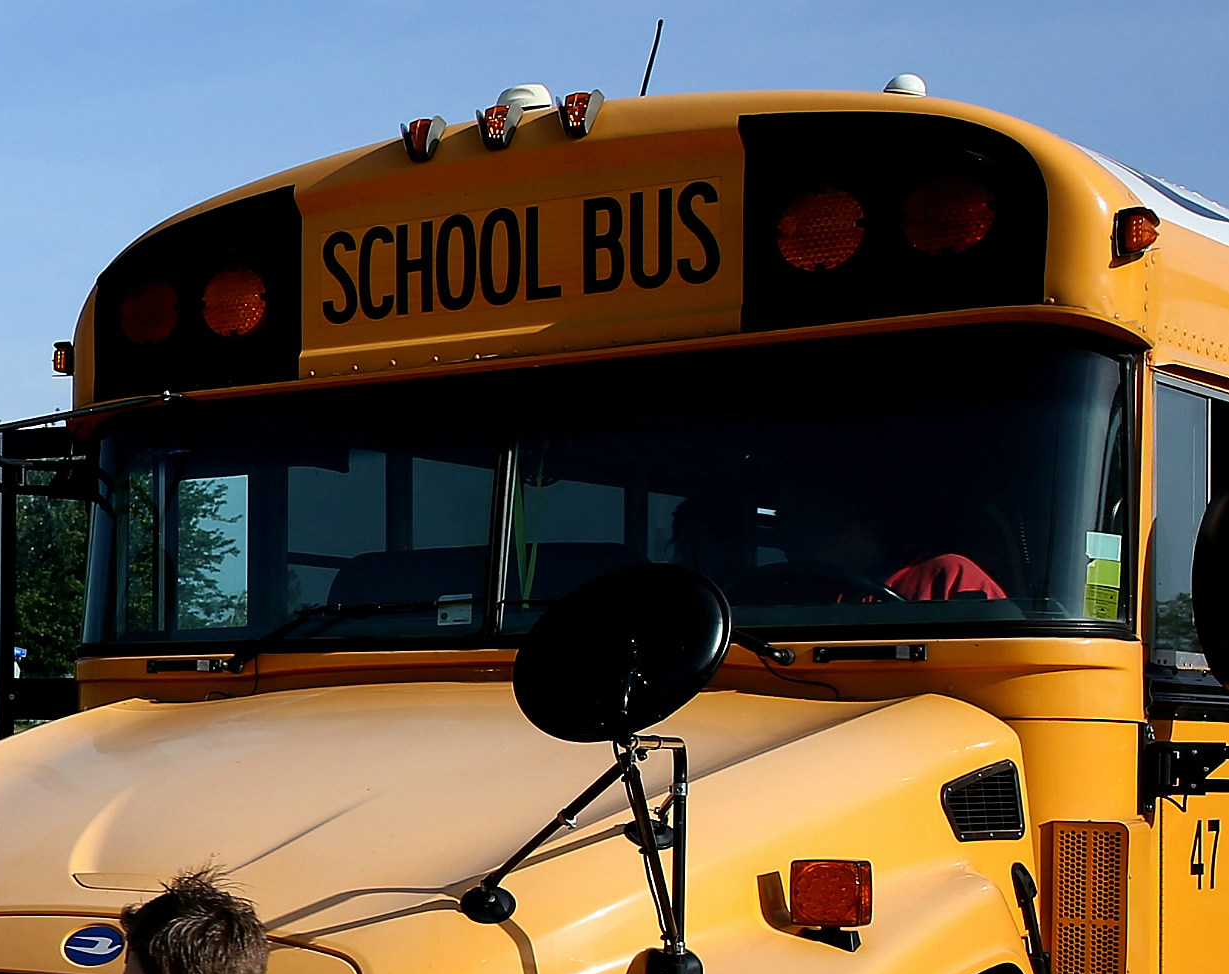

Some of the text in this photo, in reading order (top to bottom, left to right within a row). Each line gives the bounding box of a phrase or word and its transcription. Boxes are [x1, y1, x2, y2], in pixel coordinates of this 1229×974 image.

[321, 180, 721, 325] SCHOOL BUS
[1190, 819, 1221, 890] 47
